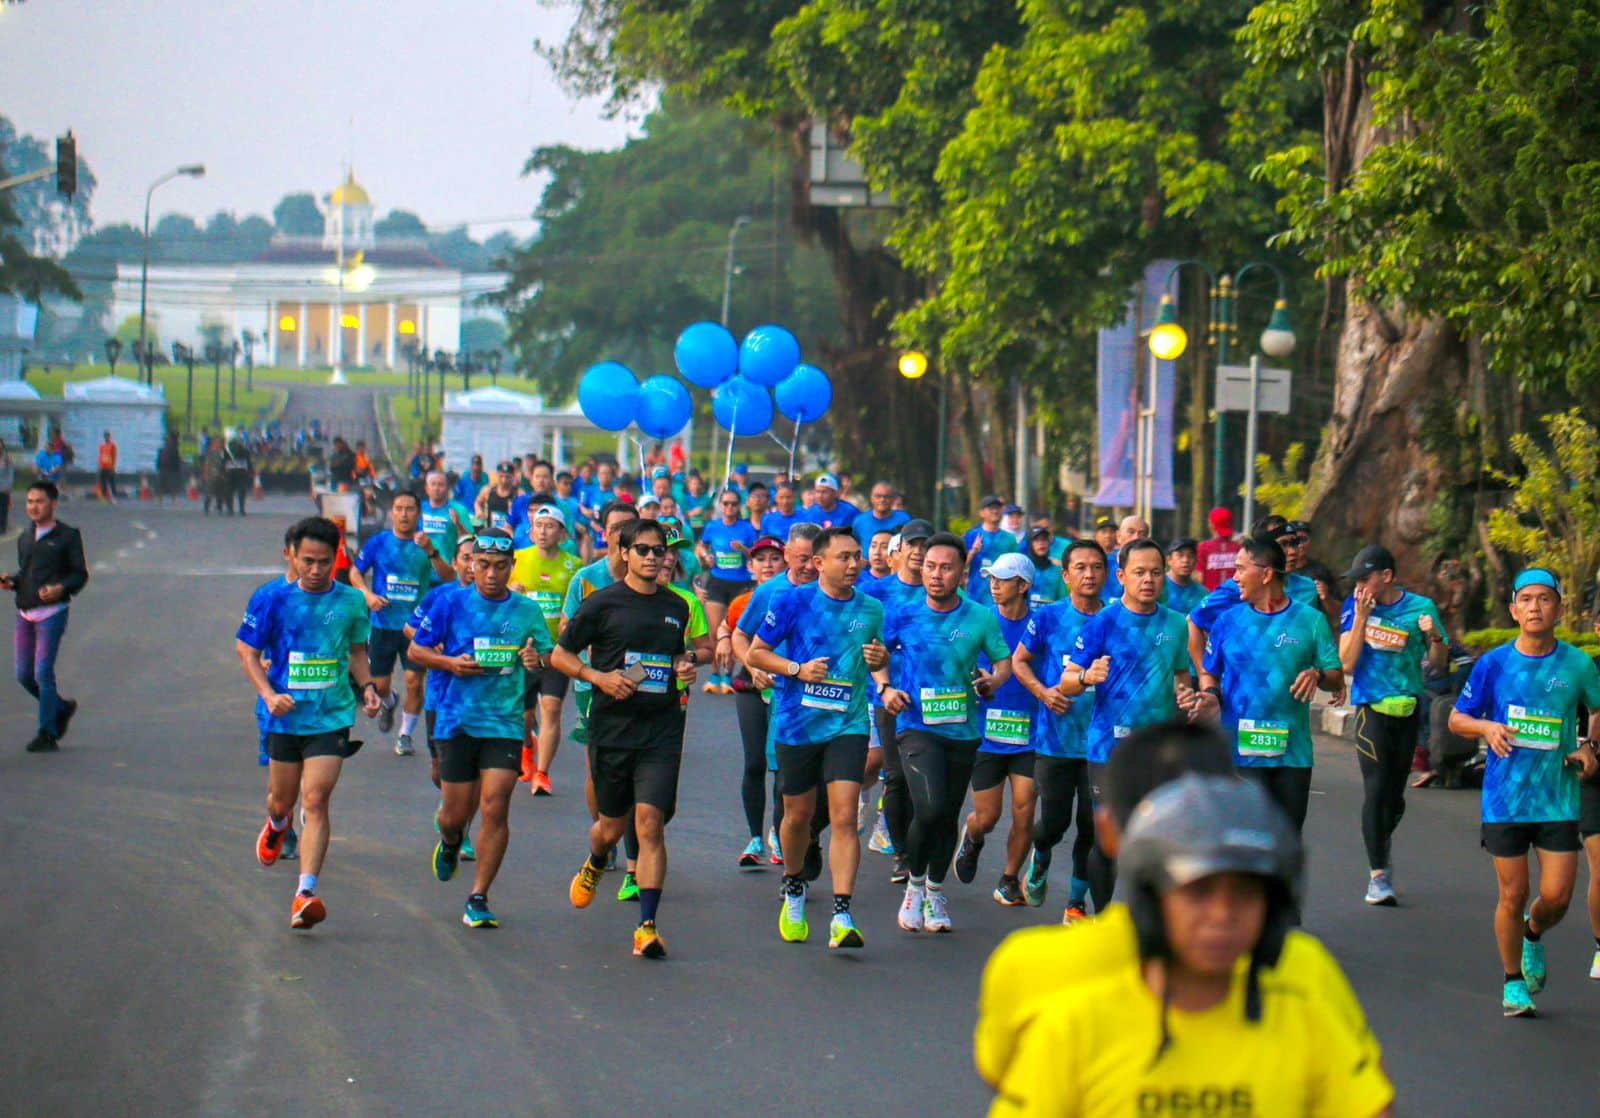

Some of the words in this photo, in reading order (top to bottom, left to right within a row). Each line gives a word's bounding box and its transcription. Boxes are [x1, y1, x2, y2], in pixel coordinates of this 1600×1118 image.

[475, 651, 512, 662] M2239
[289, 666, 329, 677] M1015
[804, 683, 844, 699] M2657
[922, 701, 959, 712] M2640
[986, 721, 1022, 733] M2714
[1250, 734, 1277, 746] 2831
